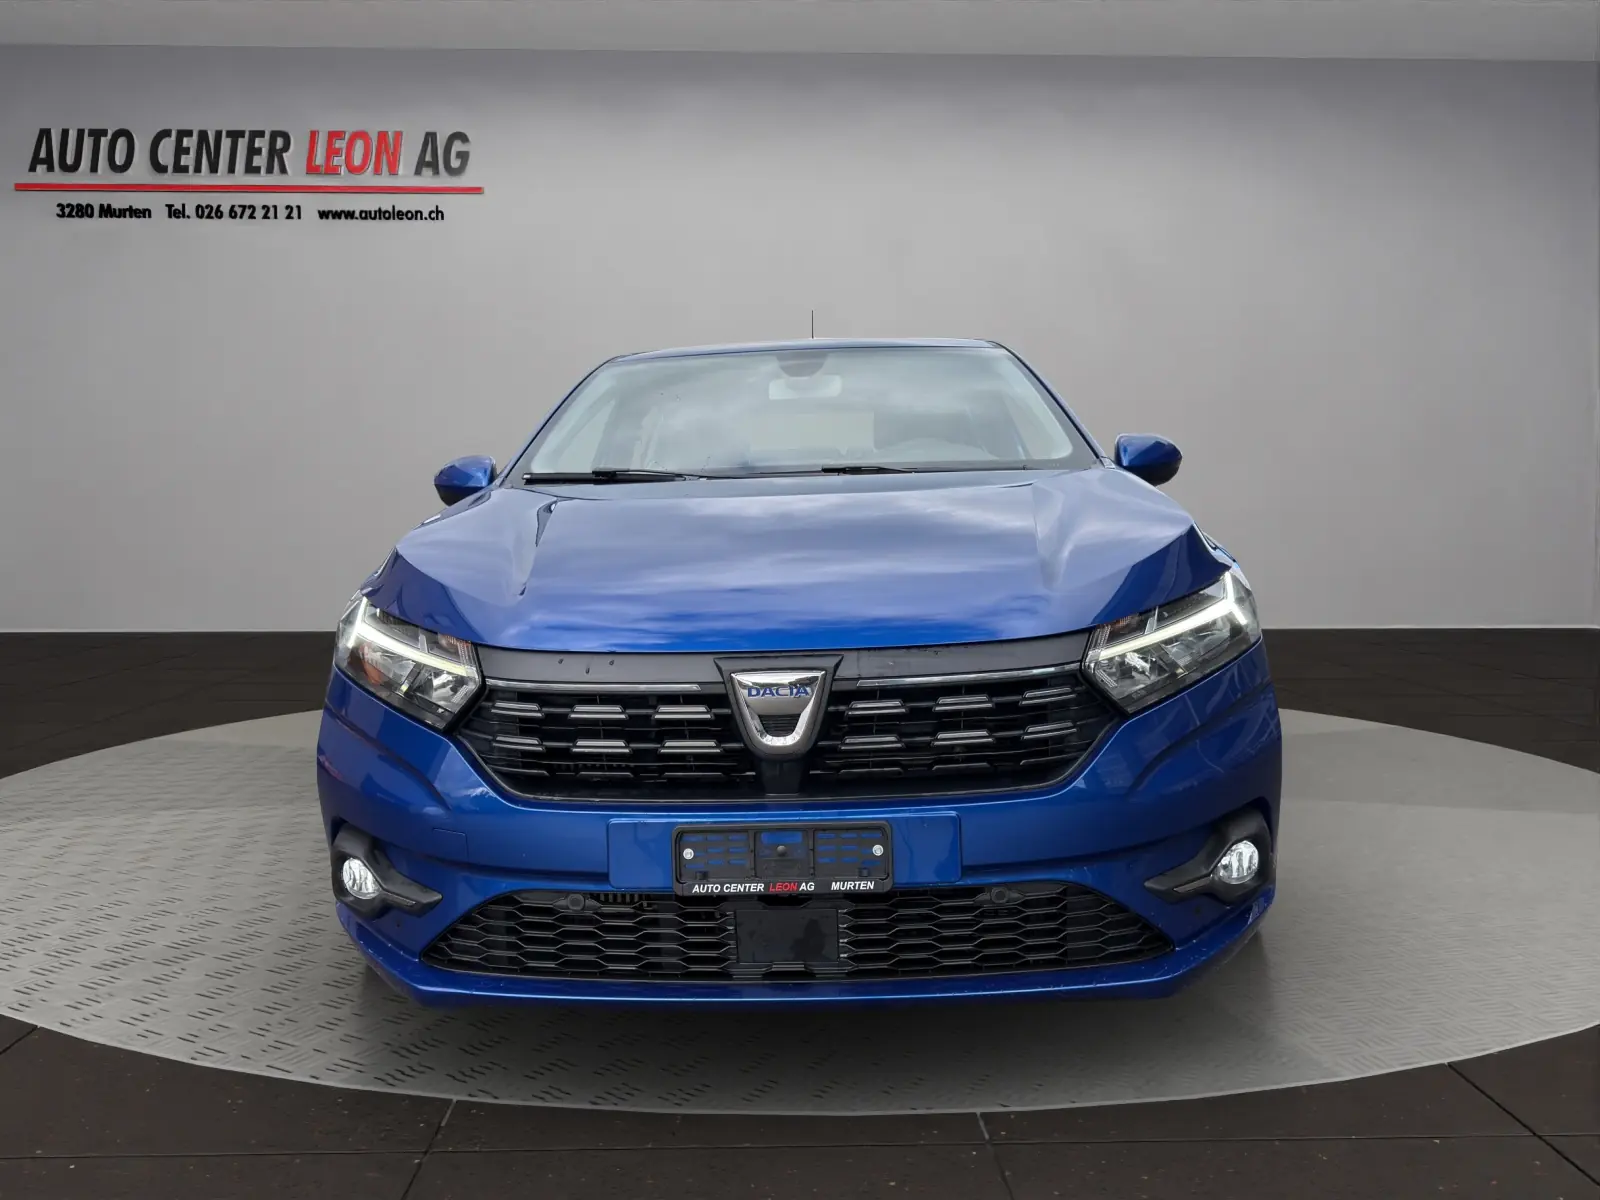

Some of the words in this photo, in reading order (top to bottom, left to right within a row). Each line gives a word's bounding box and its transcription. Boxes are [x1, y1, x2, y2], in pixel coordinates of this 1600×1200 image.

[28, 127, 136, 174] AUTO
[149, 128, 292, 175] CENTER
[305, 129, 404, 176] LEON
[413, 131, 472, 177] AG
[56, 202, 95, 220] 3280
[98, 203, 152, 220] Murten
[165, 203, 191, 220] Tel.
[195, 203, 225, 220] 026
[228, 204, 257, 220] 672
[261, 204, 279, 220] 21
[284, 204, 303, 220] 21
[317, 204, 445, 222] www.autoleon.ch
[747, 685, 810, 697] DACIA
[692, 883, 721, 894] AUTO
[723, 882, 764, 893] CENTER
[769, 882, 798, 892] LEON
[799, 881, 815, 892] AG
[831, 880, 875, 891] MURTEN
